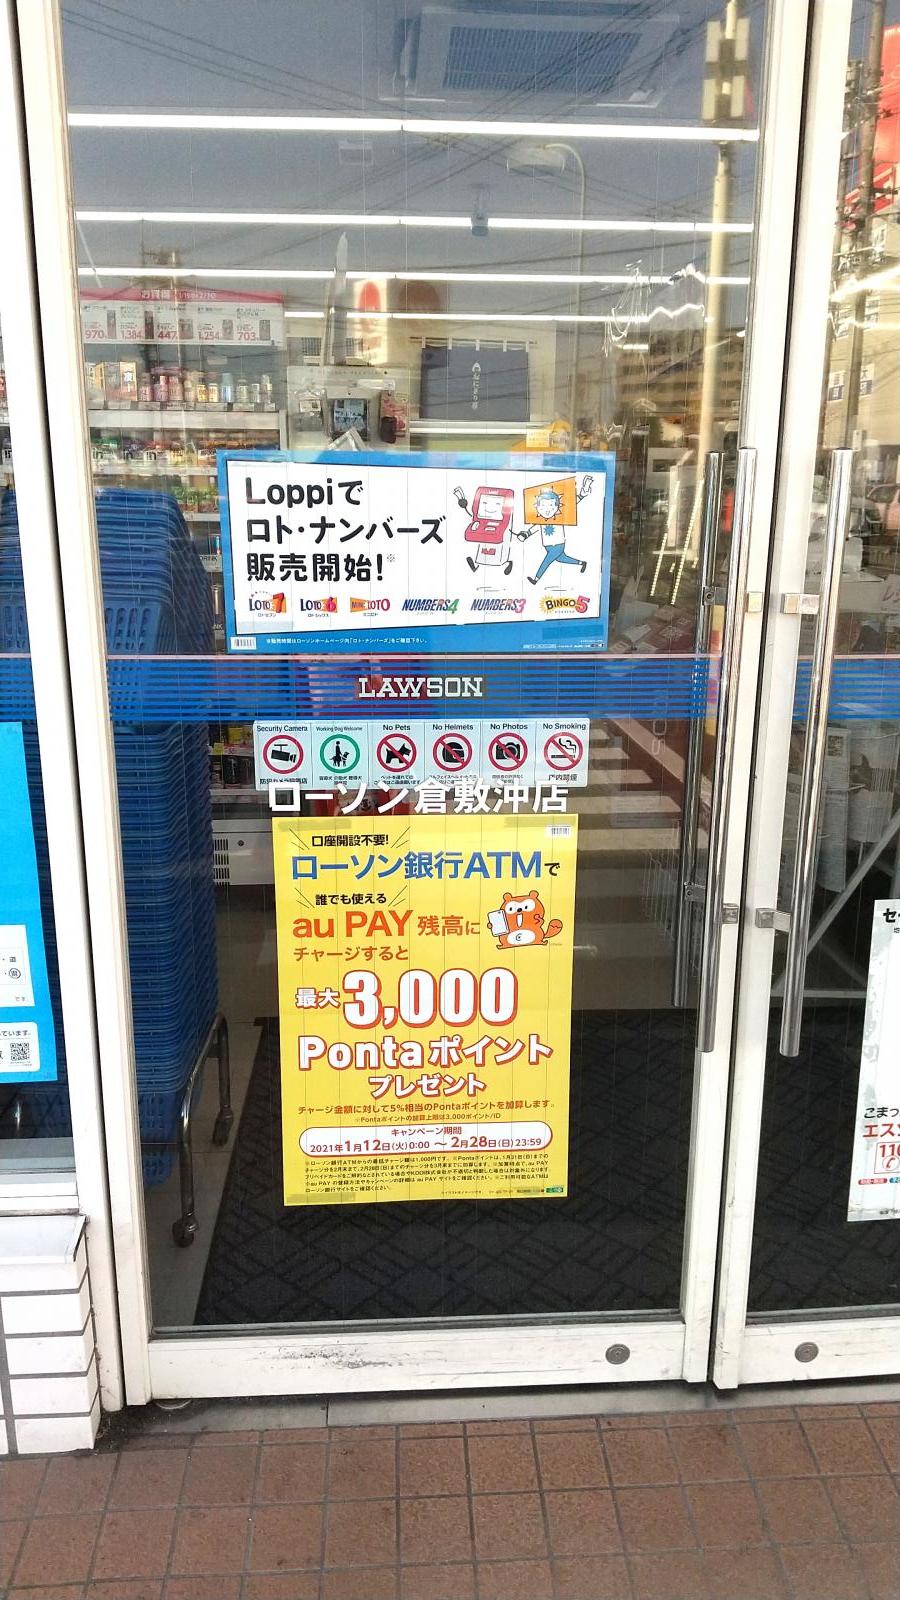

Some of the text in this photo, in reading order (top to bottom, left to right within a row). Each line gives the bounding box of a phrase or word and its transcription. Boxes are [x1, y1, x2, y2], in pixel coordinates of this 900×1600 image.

[85, 330, 105, 340] 970
[237, 331, 256, 341] 703
[245, 477, 364, 509] Loppiで
[246, 514, 446, 545] ロト・ナンバーズ
[402, 598, 460, 614] NUMBERS4
[470, 598, 526, 614] NUMBERS3
[546, 596, 590, 613] BINGO5
[358, 677, 482, 698] LAWSON
[555, 723, 586, 731] Smoking
[312, 834, 389, 847] 口座開設不要!
[292, 850, 560, 880] ローソン銀行ATMで
[315, 893, 387, 905] 誰でも使える
[293, 910, 480, 938] au PAY 残高に
[293, 946, 409, 962] チャージすると
[368, 1073, 486, 1099] プレゼント
[391, 1126, 462, 1137] キャンペーン期間
